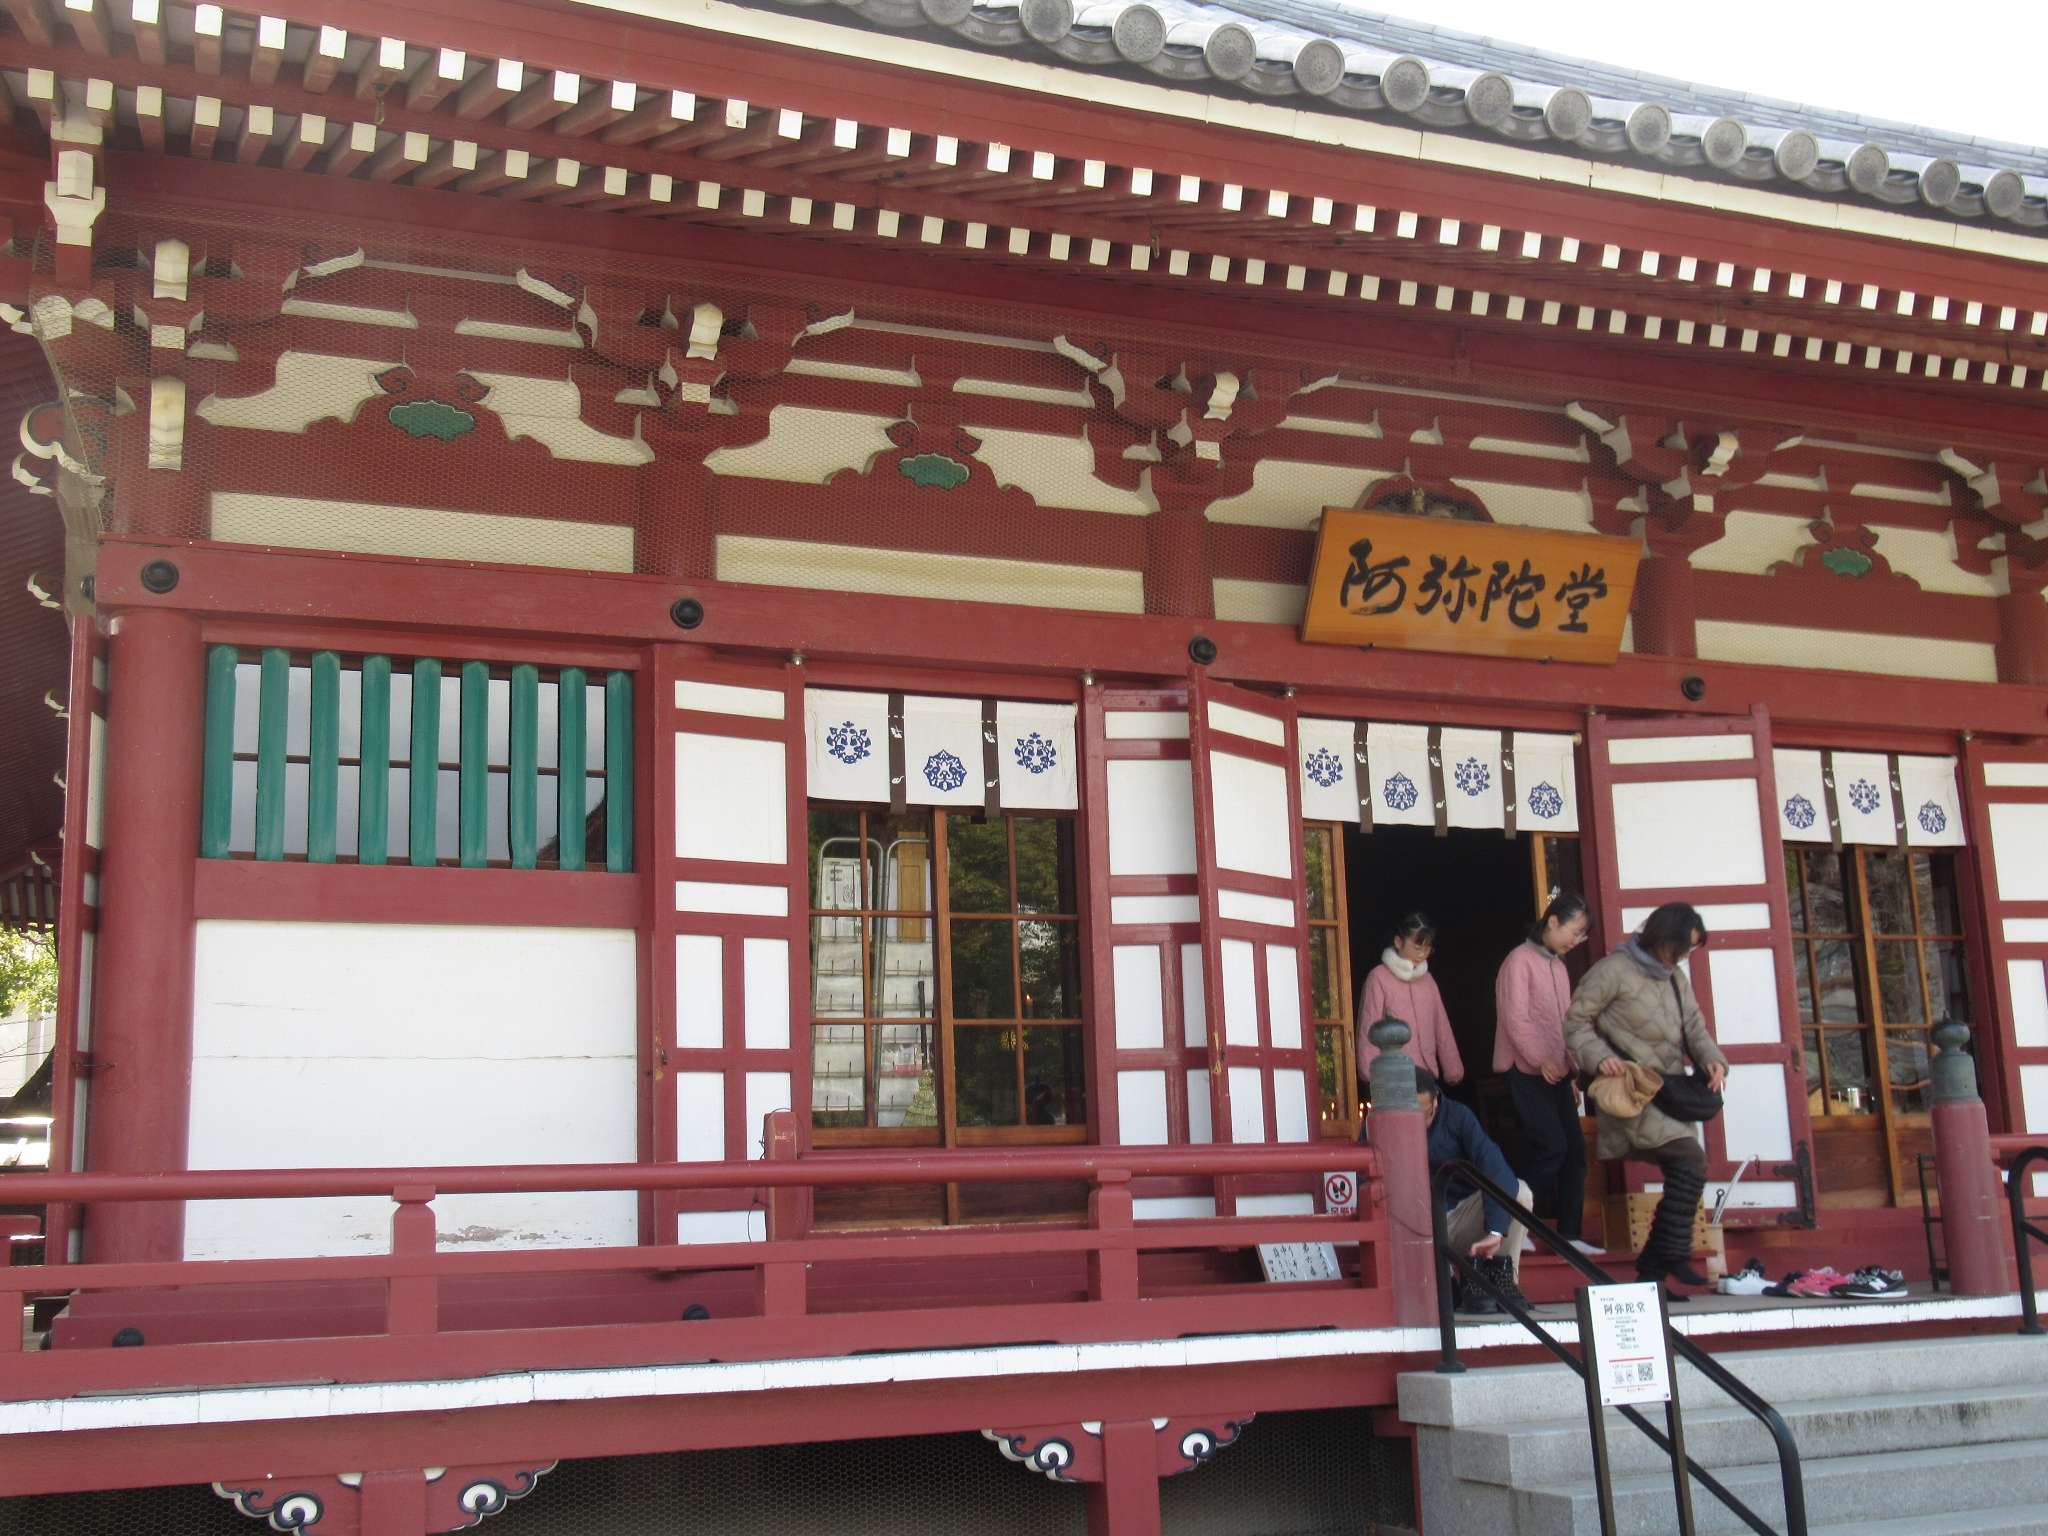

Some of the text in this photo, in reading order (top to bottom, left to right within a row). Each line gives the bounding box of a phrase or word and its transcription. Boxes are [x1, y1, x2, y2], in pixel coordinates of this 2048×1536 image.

[1340, 538, 1608, 633] 阿弥陀堂
[1603, 1301, 1646, 1315] 阿弥陀堂
